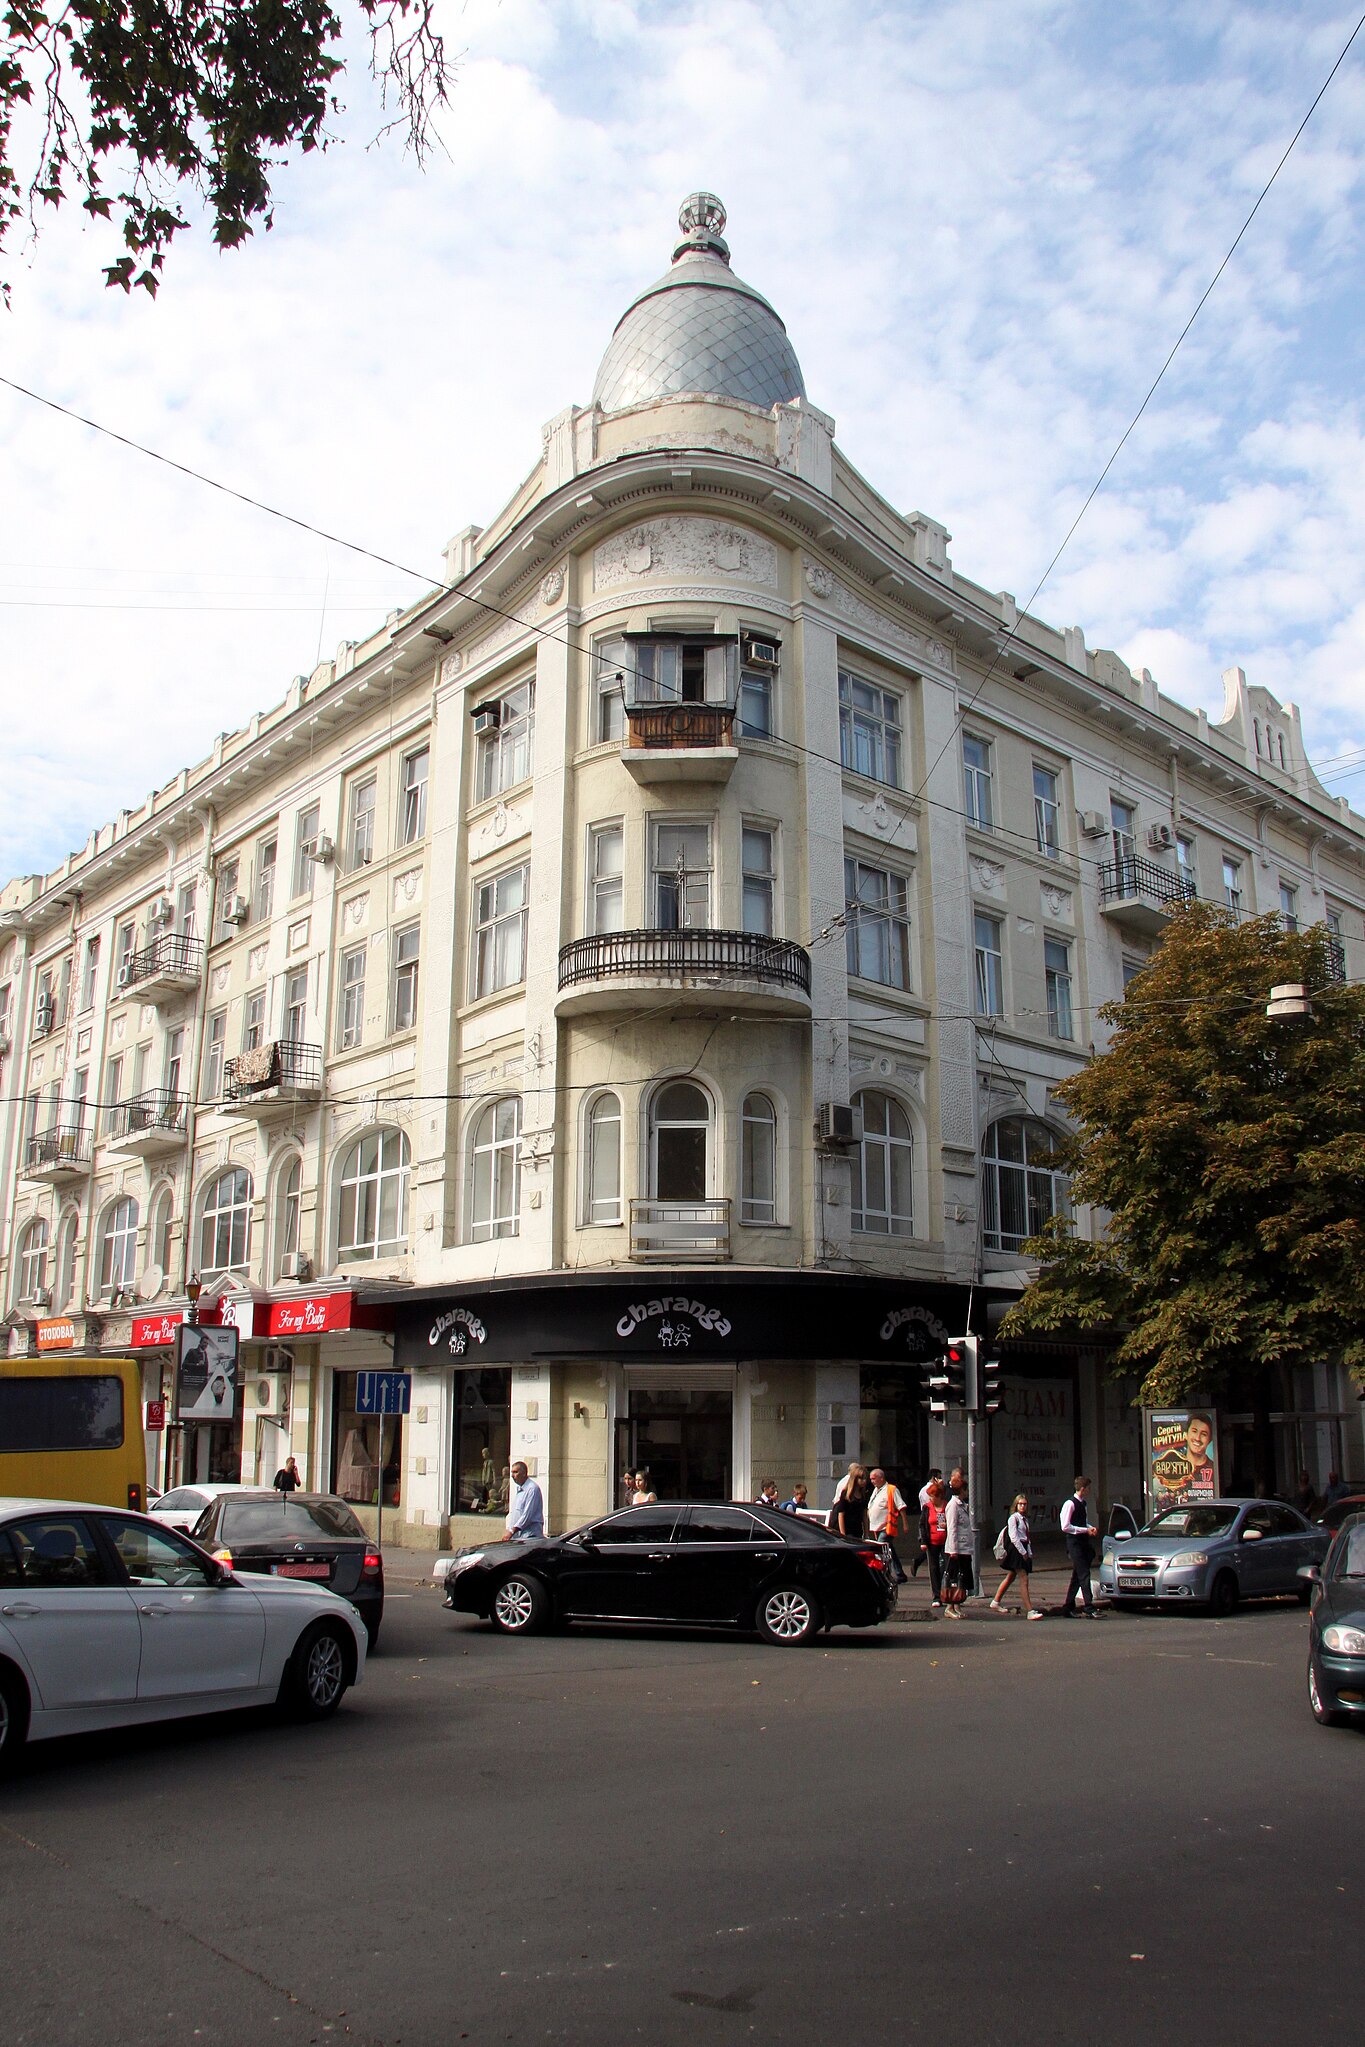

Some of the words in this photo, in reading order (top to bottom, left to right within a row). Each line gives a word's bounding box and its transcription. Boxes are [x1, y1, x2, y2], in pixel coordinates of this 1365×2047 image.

[278, 1310, 295, 1328] For
[294, 1315, 305, 1331] my
[305, 1306, 327, 1330] Baby
[39, 1324, 75, 1342] СТОЛОВАЯ
[1157, 1423, 1182, 1437] Сергій
[1152, 1431, 1188, 1447] ПРИТУЛА
[1200, 1468, 1214, 1482] 17
